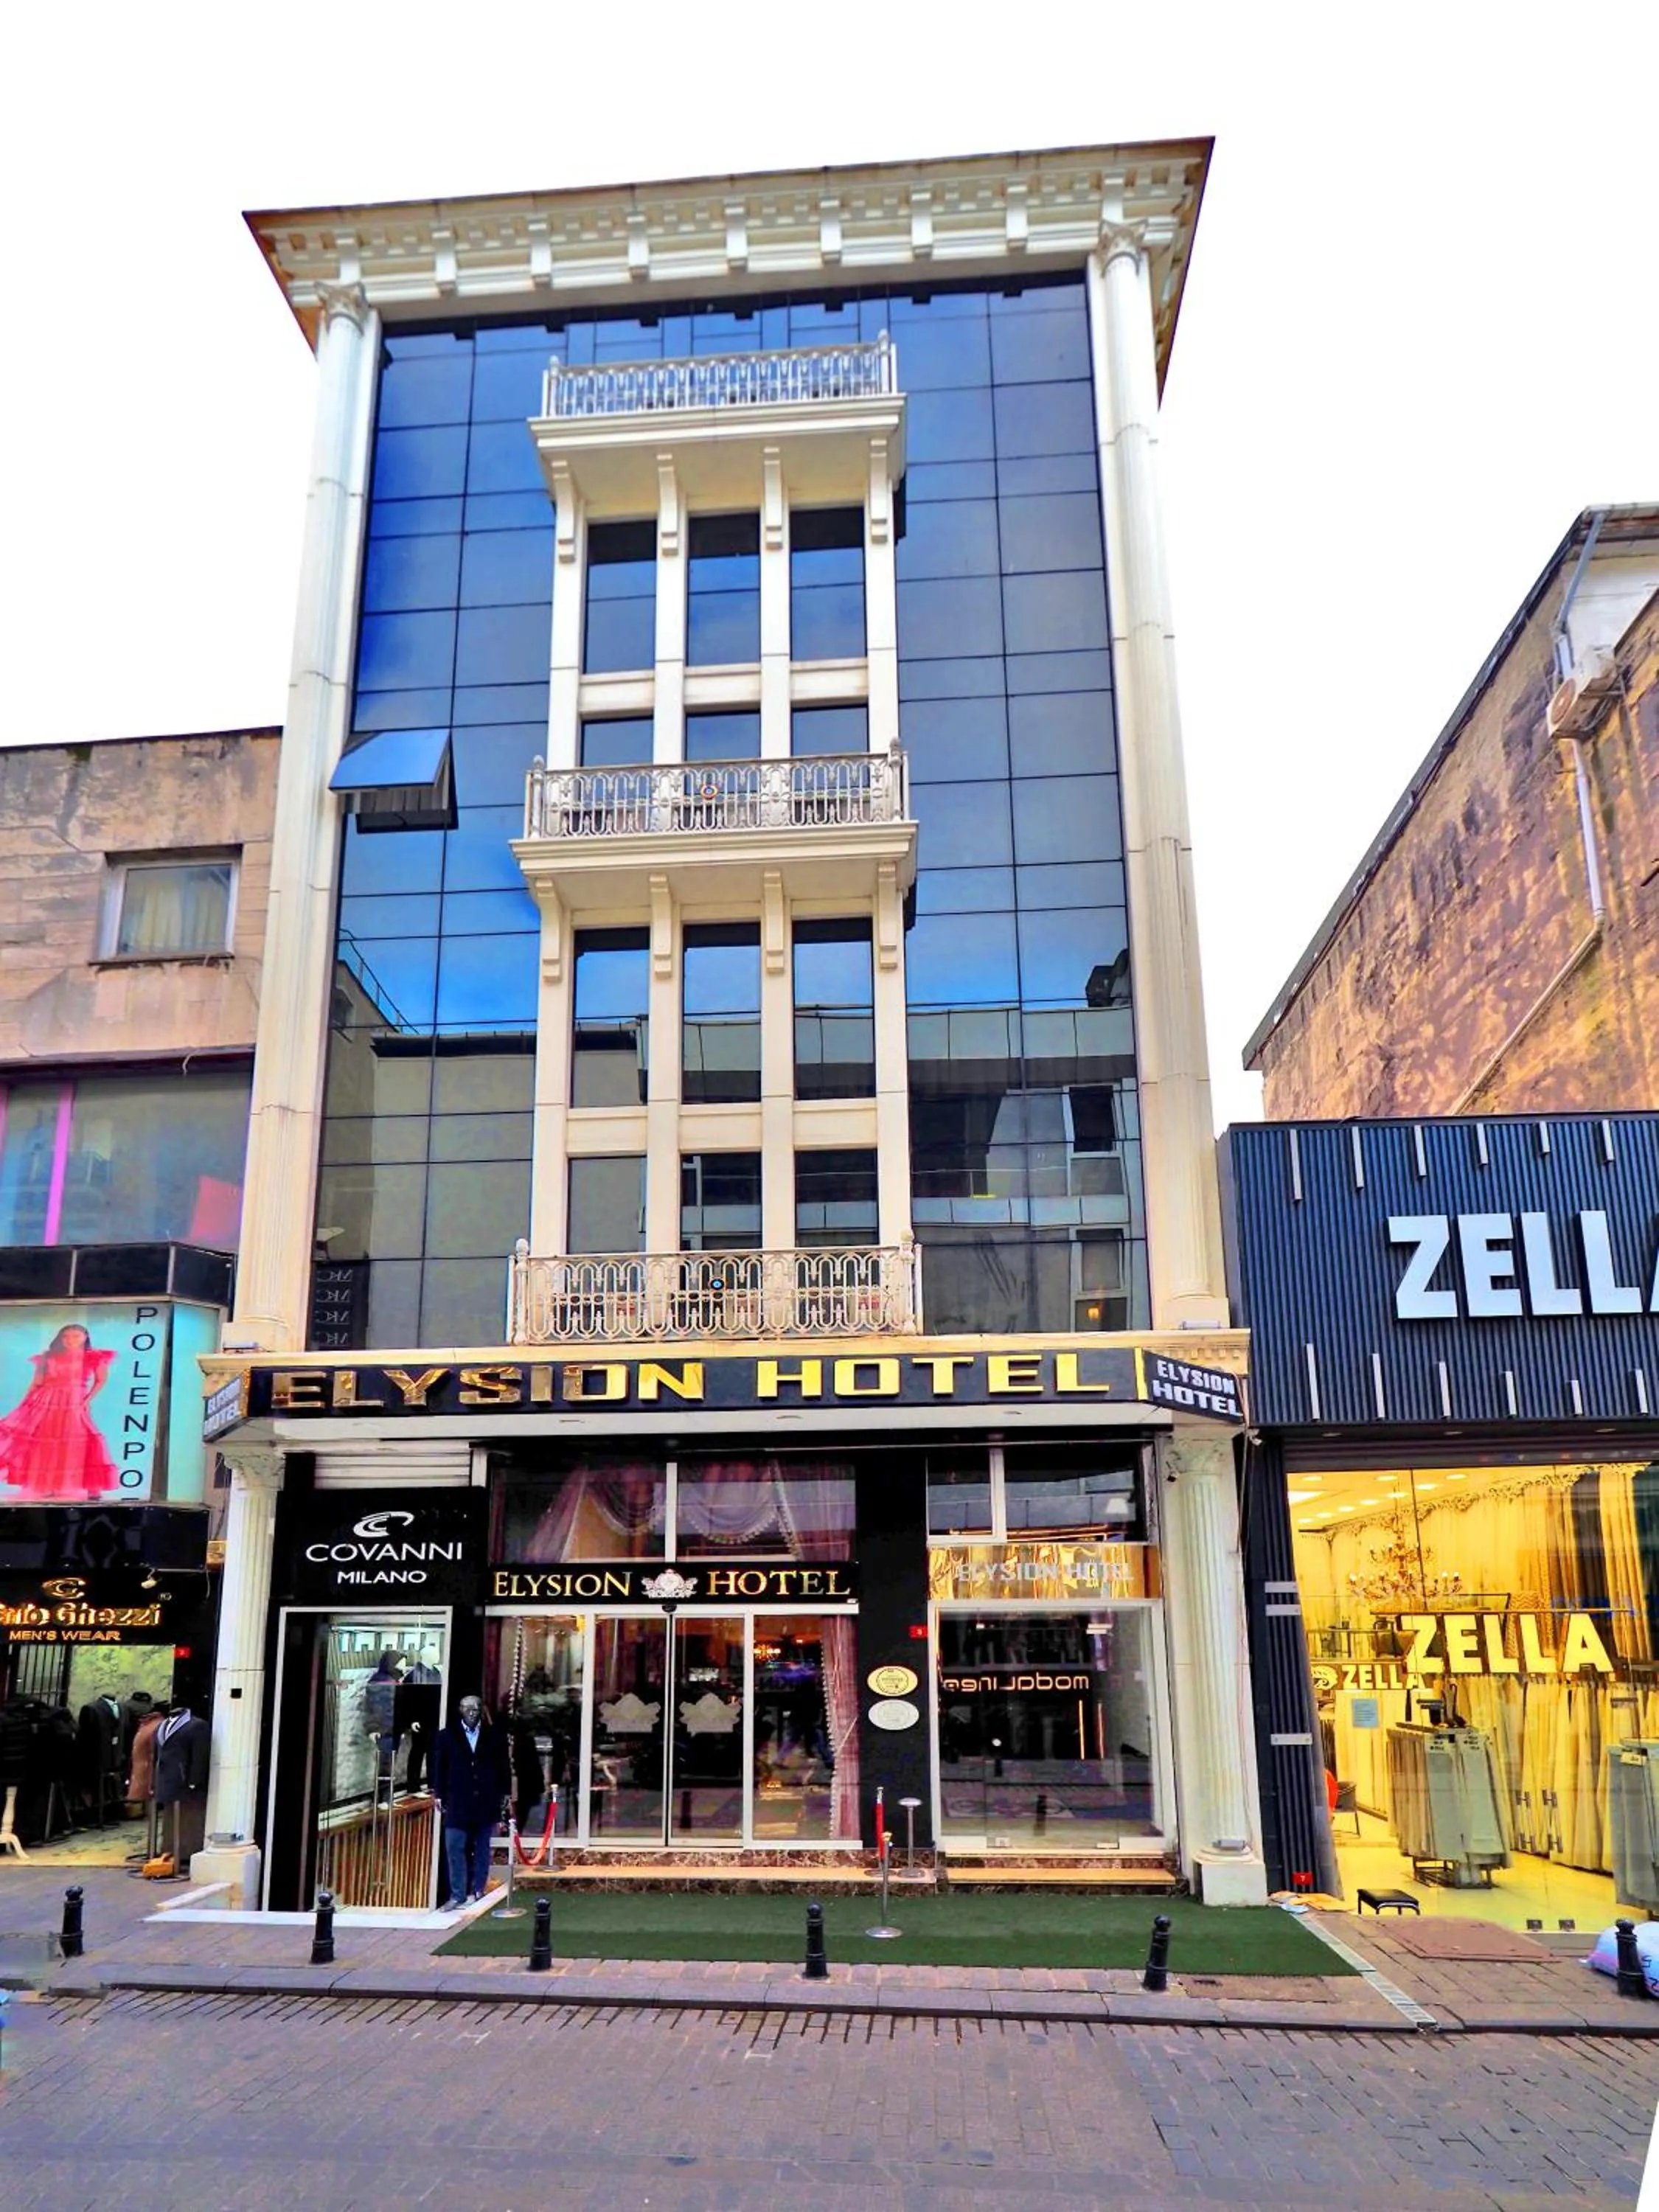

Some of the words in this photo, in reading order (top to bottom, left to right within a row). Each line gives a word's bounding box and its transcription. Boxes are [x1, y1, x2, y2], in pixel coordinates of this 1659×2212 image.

[1387, 1210, 1659, 1319] ZELL
[271, 1362, 706, 1408] ELYSION
[757, 1353, 1110, 1398] HOTEL
[1156, 1359, 1235, 1395] ELYSION
[119, 1307, 159, 1500] POLENPO
[1152, 1380, 1244, 1416] HOTEL
[305, 1542, 462, 1562] COVANNI
[337, 1571, 427, 1584] MILANO
[493, 1571, 631, 1596] ELYSION
[706, 1571, 852, 1596] HOTEL
[9, 1630, 58, 1641] MEN'S
[62, 1630, 122, 1641] WEAR
[1400, 1614, 1614, 1673] ZELLA
[1341, 1664, 1426, 1689] ZELLA
